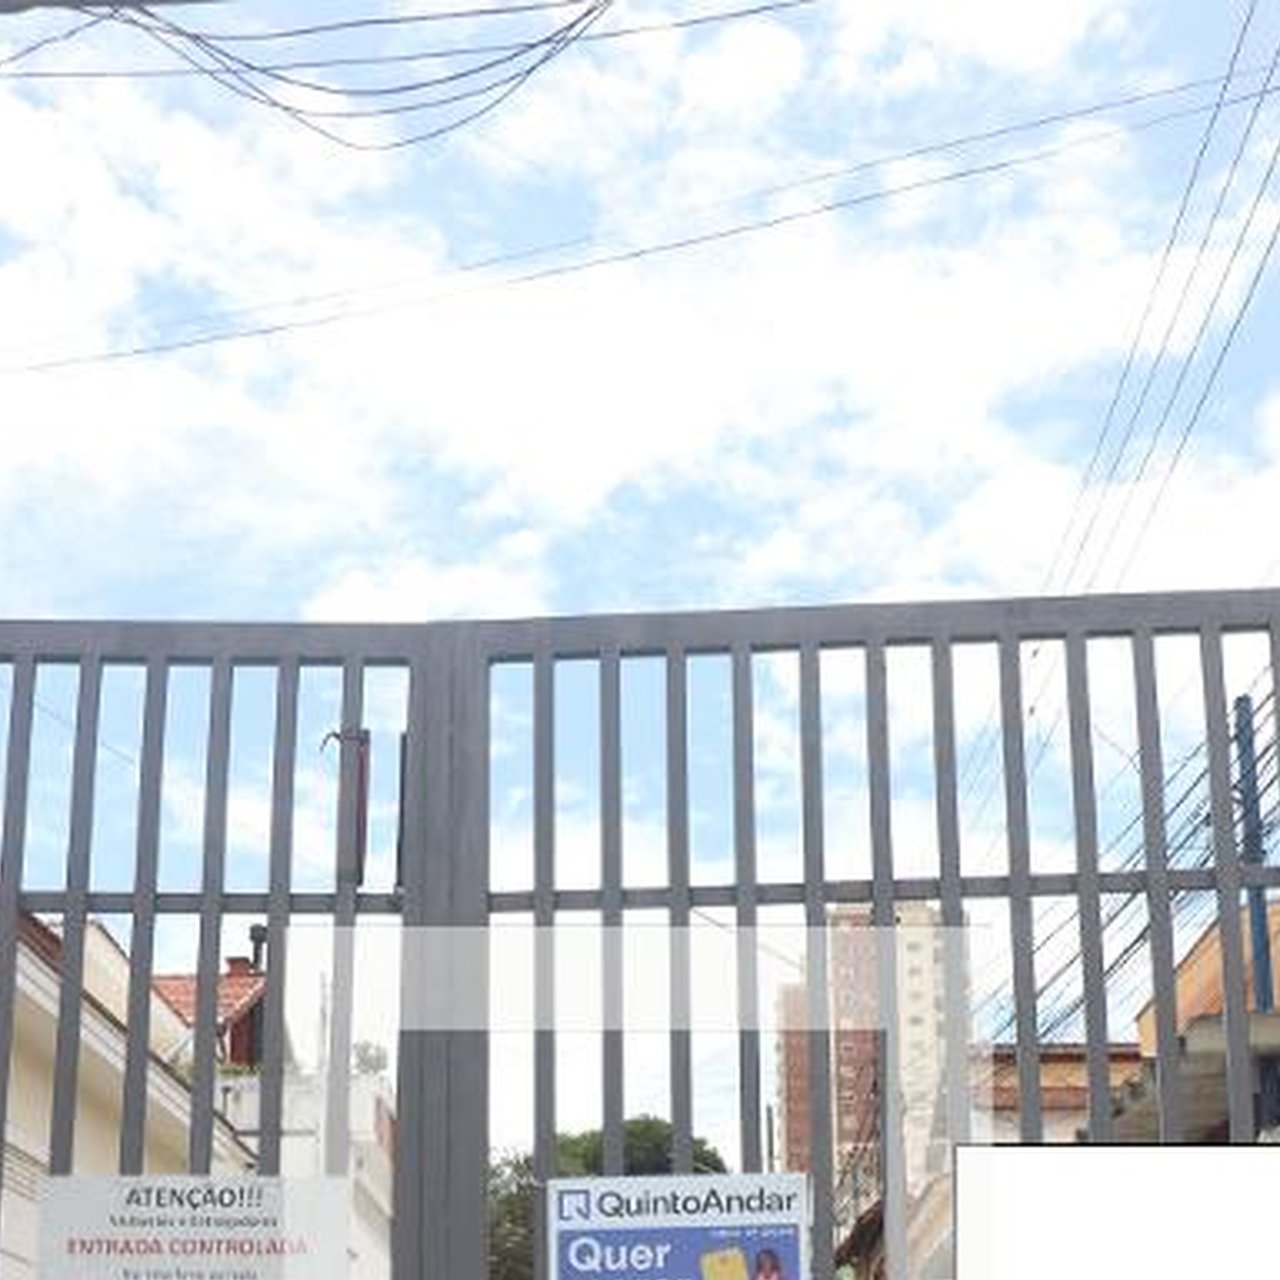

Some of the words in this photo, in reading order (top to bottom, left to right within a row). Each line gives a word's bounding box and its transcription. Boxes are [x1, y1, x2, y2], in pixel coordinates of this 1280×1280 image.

[598, 1188, 798, 1218] QuintoAndar
[66, 1237, 163, 1255] ENTRADA
[169, 1237, 308, 1255] CONTROLADA
[568, 1236, 672, 1273] Quer
